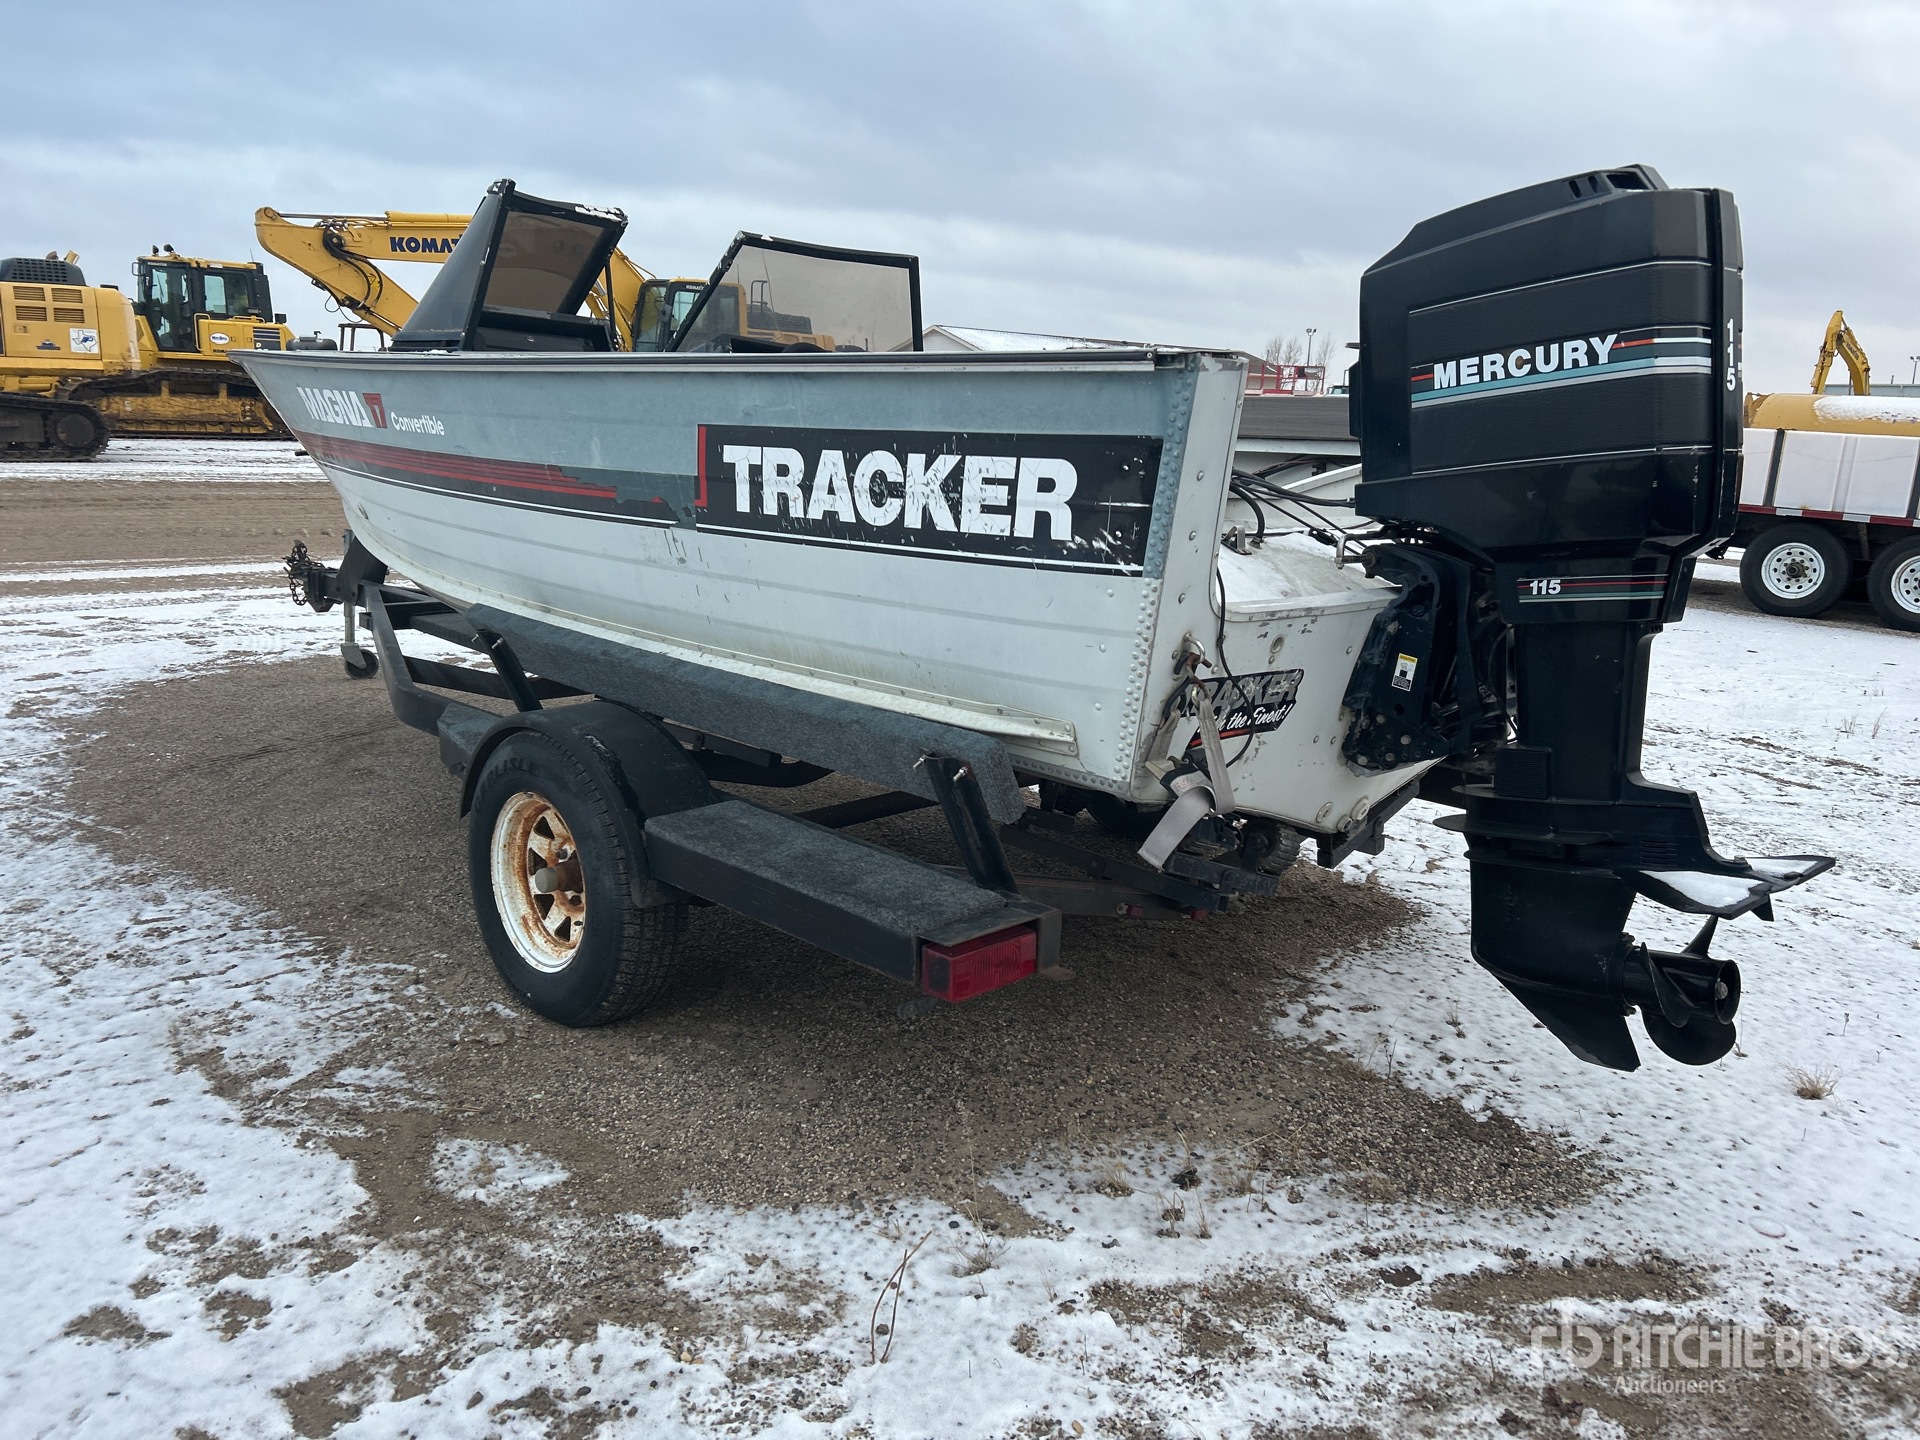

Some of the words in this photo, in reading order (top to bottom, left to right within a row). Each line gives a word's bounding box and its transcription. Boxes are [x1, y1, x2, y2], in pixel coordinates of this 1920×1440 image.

[1433, 334, 1618, 389] MERCURY
[1726, 318, 1736, 391] 115
[297, 387, 373, 428] MAGNA
[390, 411, 445, 436] Convertible
[723, 445, 1078, 541] TRACKER
[1530, 580, 1561, 595] 115
